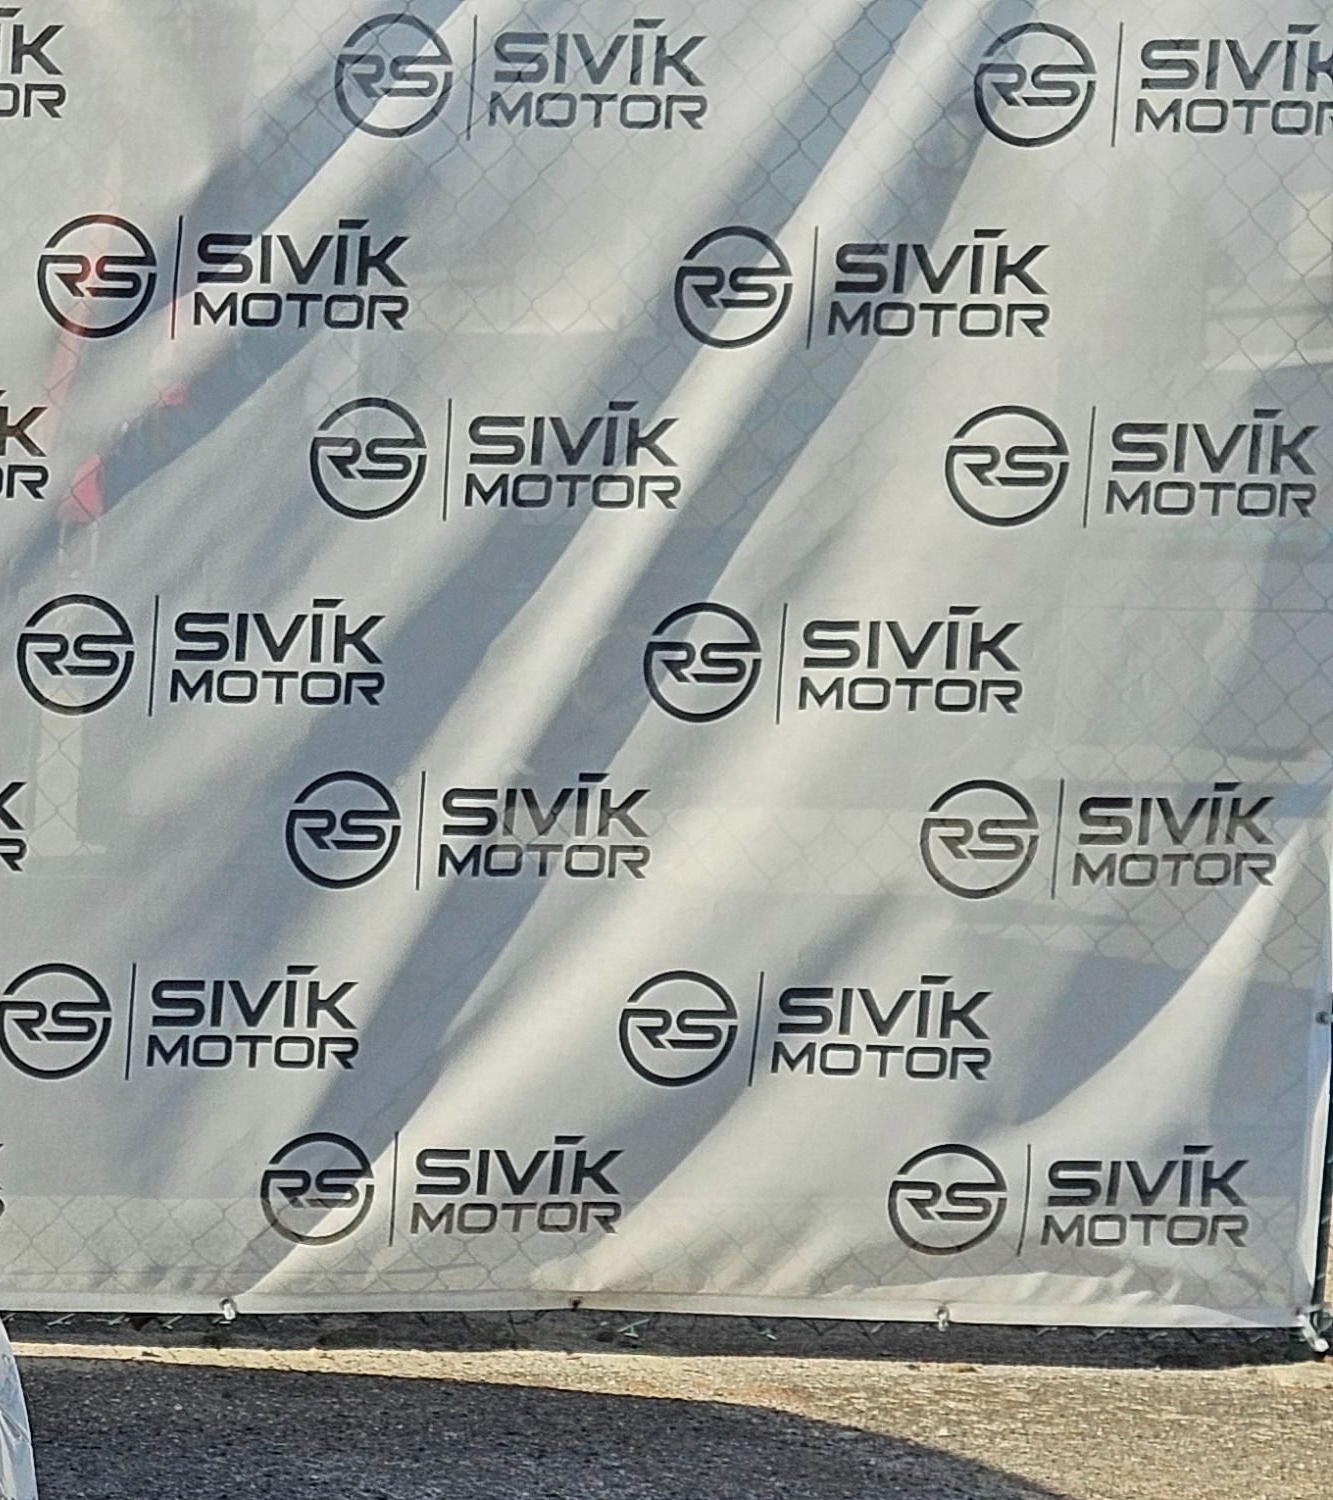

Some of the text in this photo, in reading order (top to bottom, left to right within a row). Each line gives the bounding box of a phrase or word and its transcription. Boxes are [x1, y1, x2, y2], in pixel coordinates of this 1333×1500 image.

[489, 92, 707, 129] MOTOR
[194, 292, 409, 330] MOTOR
[828, 301, 1050, 337] MOTOR
[465, 473, 681, 509] MOTOR
[1106, 480, 1316, 517] MOTOR
[170, 669, 384, 705] MOTOR
[799, 676, 1022, 713] MOTOR
[438, 843, 650, 878] MOTOR
[1073, 852, 1275, 886] MOTOR
[147, 1034, 359, 1069] MOTOR
[771, 1041, 991, 1080] MOTOR
[411, 1202, 621, 1234] MOTOR
[1040, 1214, 1248, 1247] MOTOR
